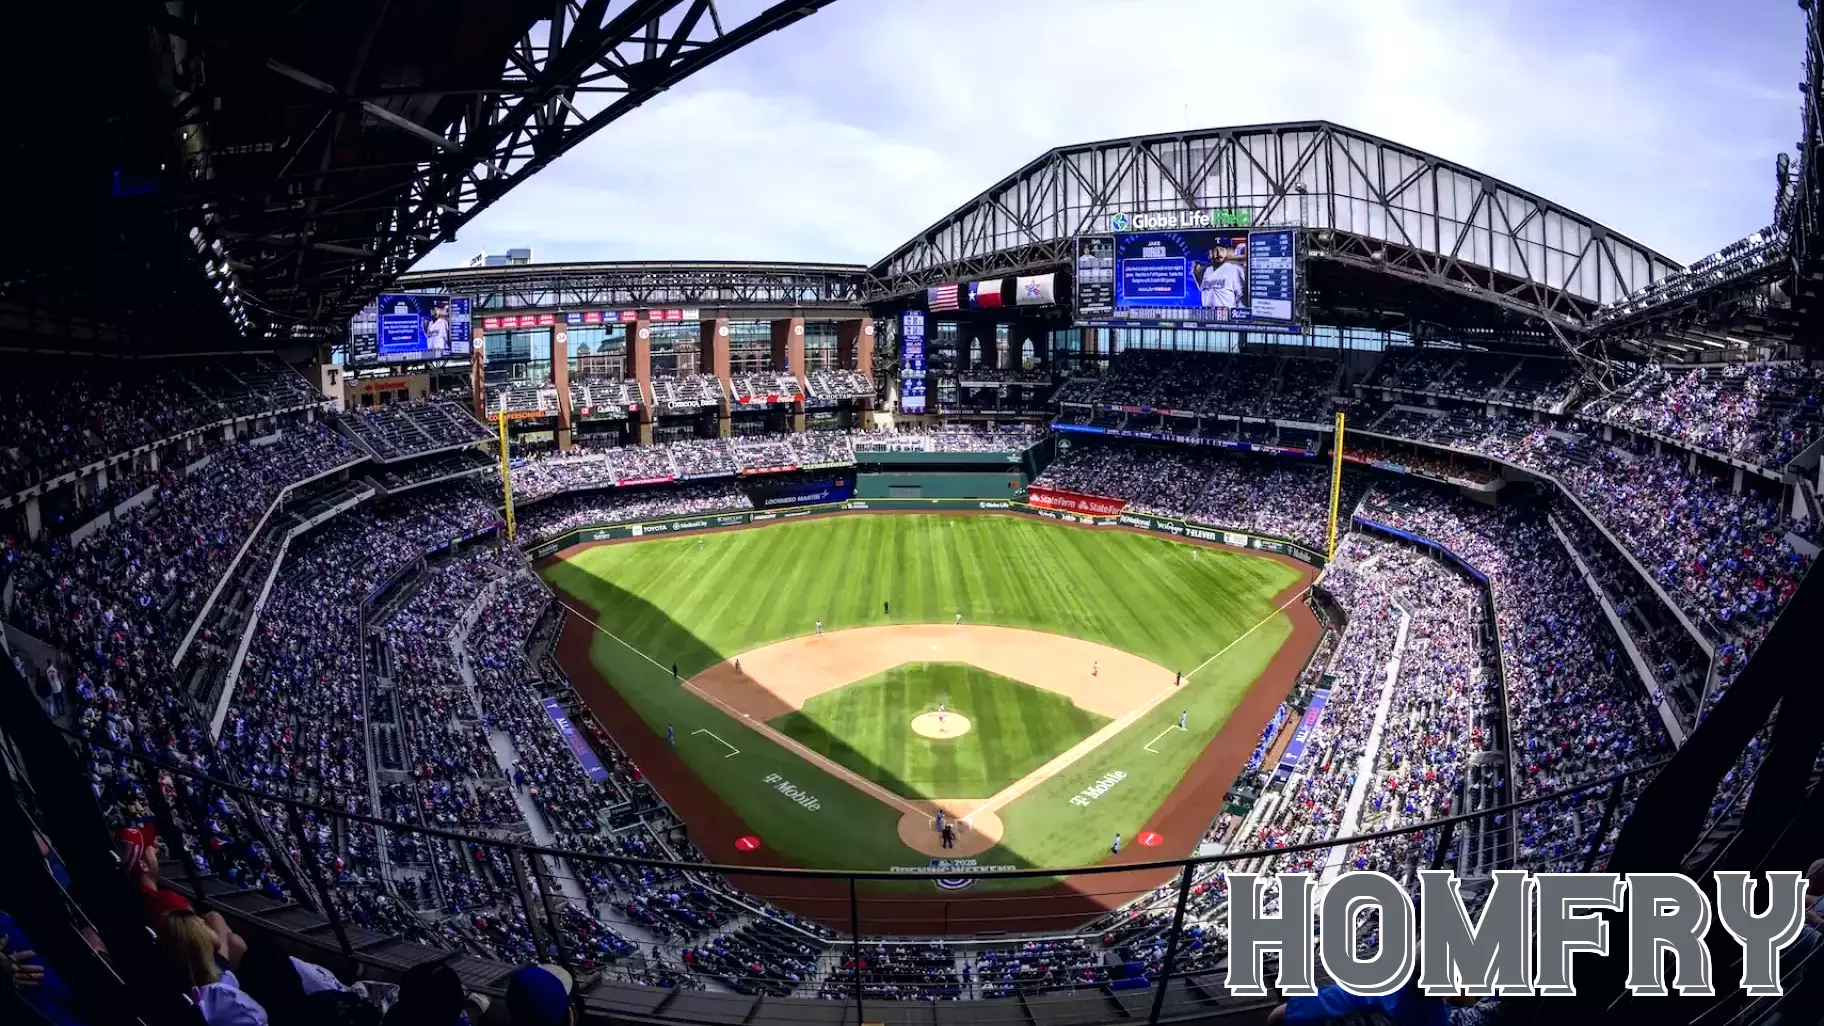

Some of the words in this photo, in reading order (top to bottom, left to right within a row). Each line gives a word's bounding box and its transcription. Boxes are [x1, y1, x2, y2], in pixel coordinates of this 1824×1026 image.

[1132, 213, 1177, 229] Globe
[1180, 210, 1210, 227] Life
[327, 369, 338, 385] T
[765, 495, 796, 505] LOCKHEED
[798, 493, 821, 502] MARTIN
[643, 524, 668, 532] TOYOTA
[1185, 528, 1216, 541] 7-ELEVEN
